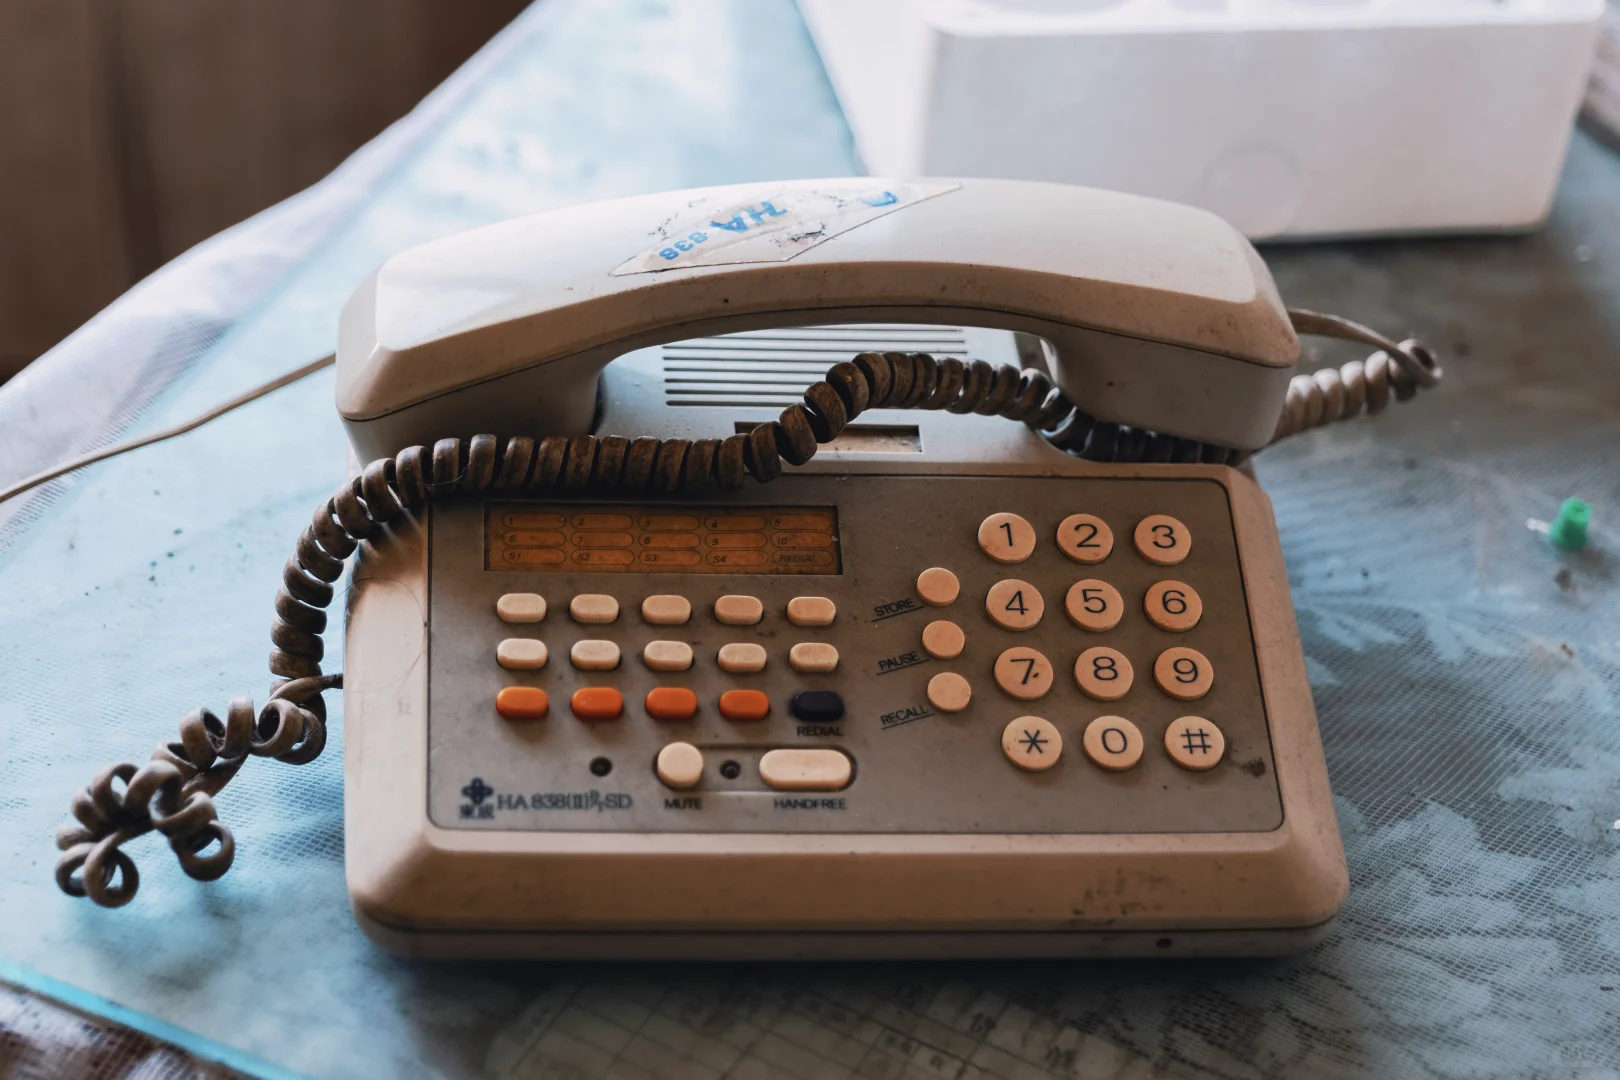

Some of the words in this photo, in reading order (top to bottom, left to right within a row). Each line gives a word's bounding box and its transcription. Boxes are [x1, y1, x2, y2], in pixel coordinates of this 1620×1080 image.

[710, 200, 788, 233] HA
[658, 231, 709, 261] 838
[999, 522, 1014, 547] 1
[1073, 523, 1101, 548] 2
[1151, 524, 1177, 549] 3
[508, 552, 522, 561] S1
[577, 553, 591, 562] S2
[643, 554, 658, 562] S3
[713, 555, 727, 563] S4
[779, 555, 817, 563] REDIAL
[874, 597, 915, 618] STORE
[1005, 590, 1029, 615] 4
[1081, 589, 1107, 614] 5
[1161, 590, 1187, 615] 6
[878, 650, 921, 671] PAUSE
[1010, 658, 1035, 685] 7
[1092, 656, 1119, 681] 8
[1172, 658, 1199, 683] 9
[880, 704, 929, 726] RECALL
[796, 725, 844, 737] REDIAL
[1180, 728, 1212, 754] #
[497, 793, 528, 810] HA
[664, 798, 703, 810] MUTE
[774, 798, 848, 810] HANDFREE
